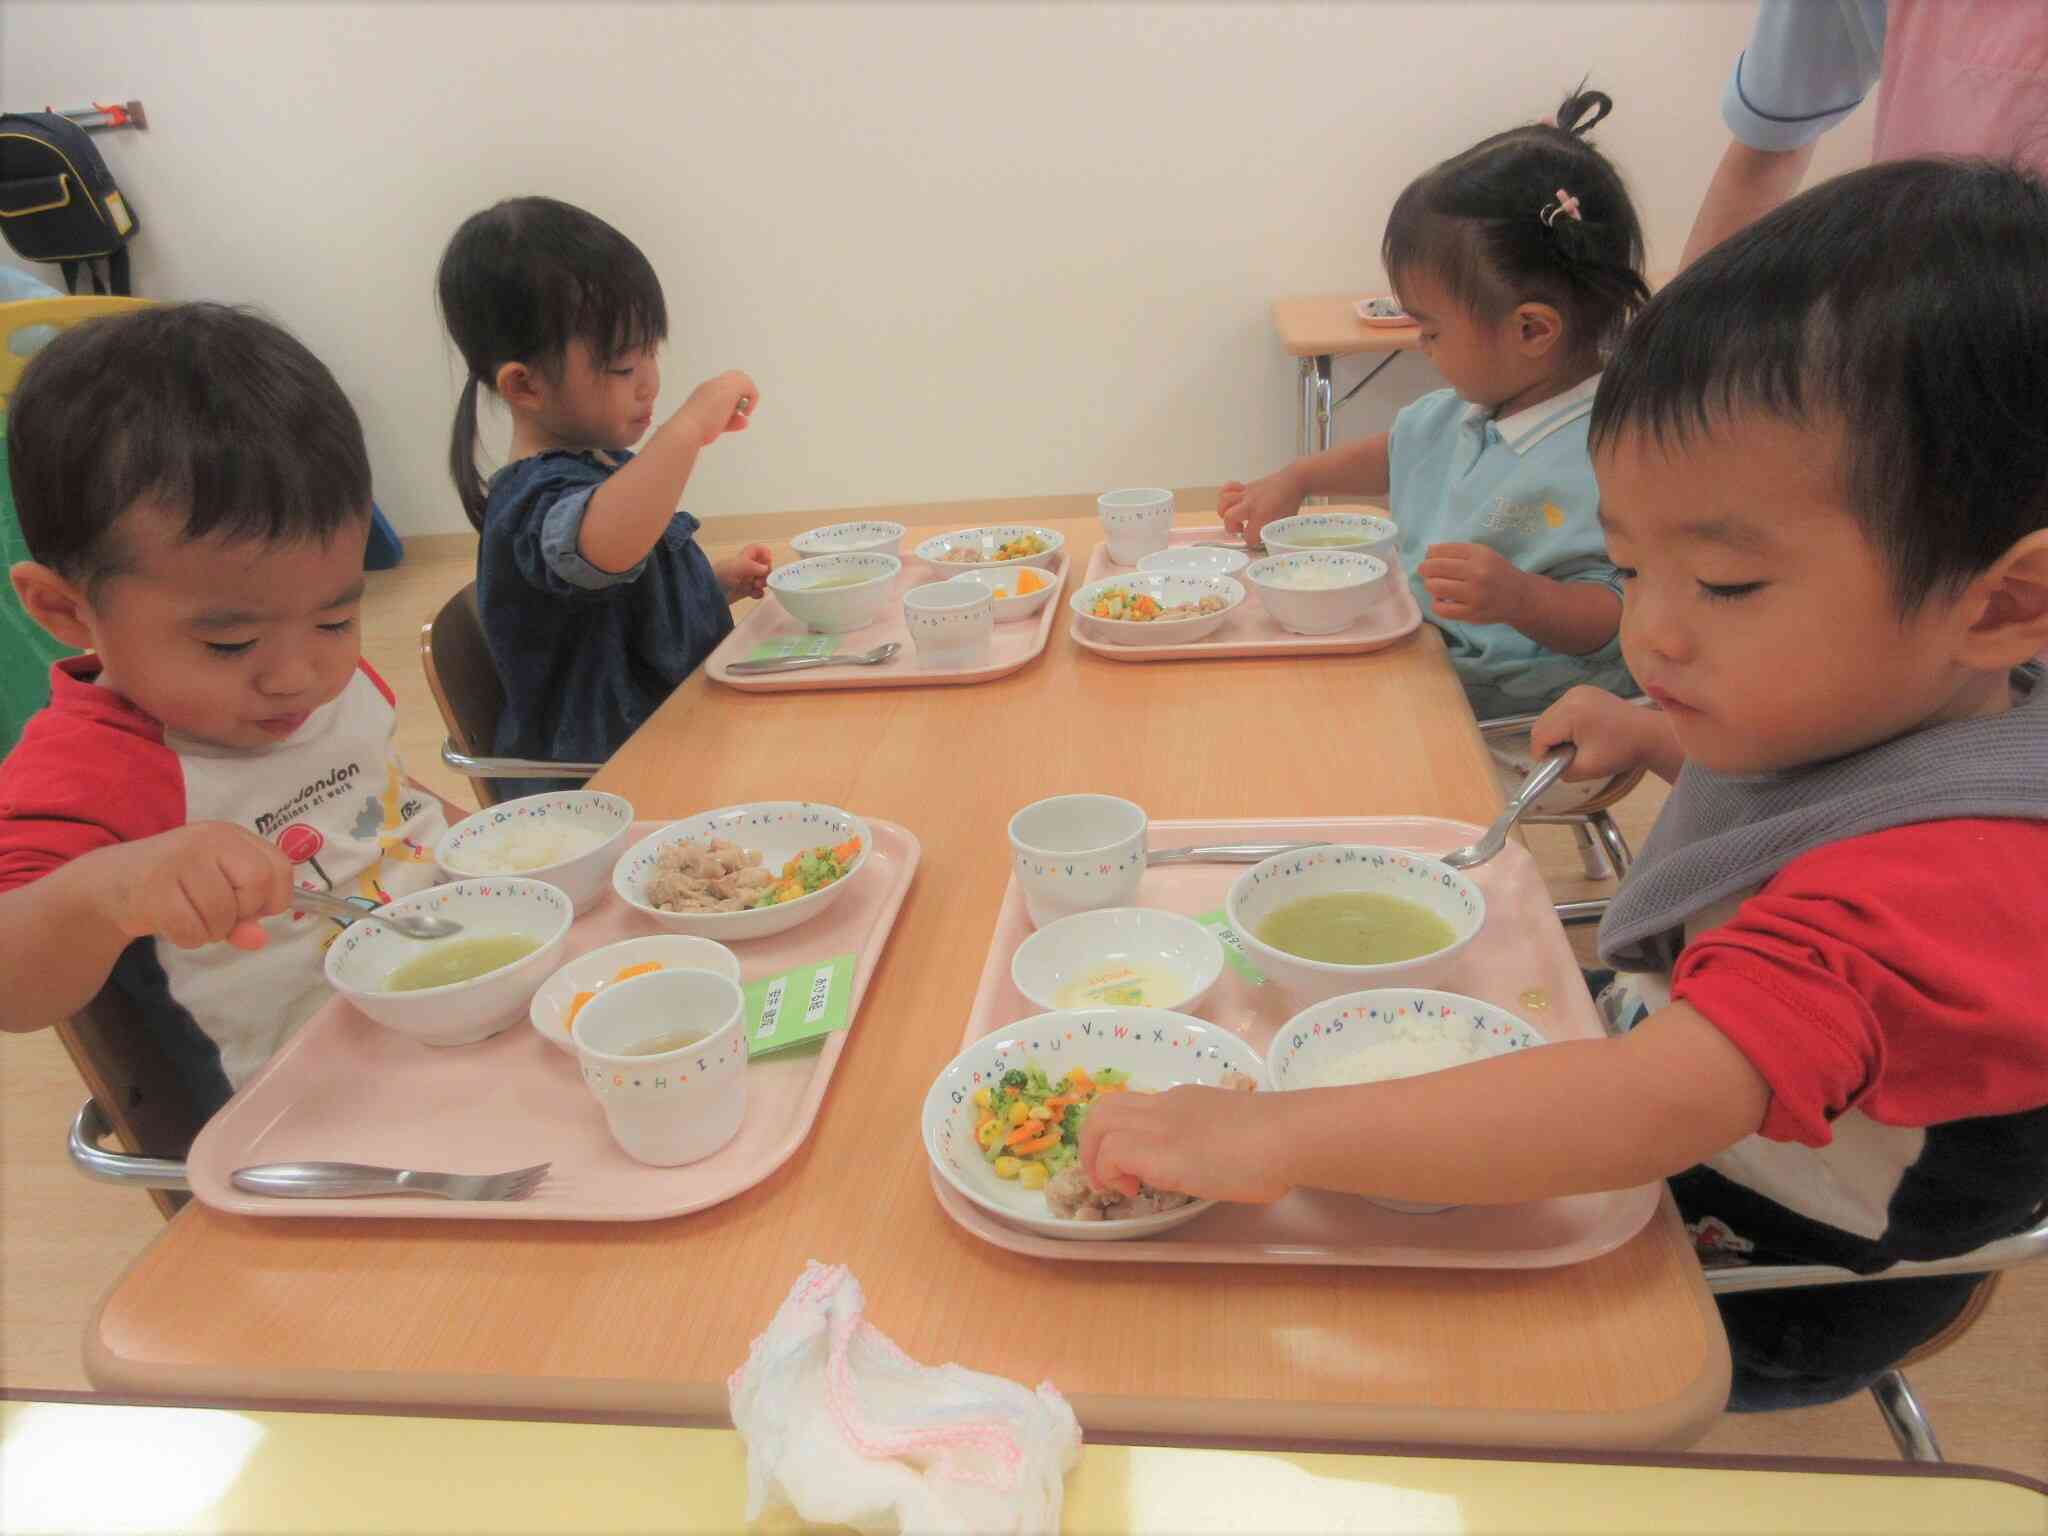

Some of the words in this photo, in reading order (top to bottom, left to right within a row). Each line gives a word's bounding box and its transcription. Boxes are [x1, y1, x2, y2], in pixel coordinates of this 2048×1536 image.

[1333, 1018, 1344, 1032] S
[1413, 999, 1424, 1013] V
[1473, 1015, 1486, 1030] X
[1081, 1021, 1093, 1035] V
[1113, 1024, 1129, 1039] W
[1153, 1029, 1164, 1043] X
